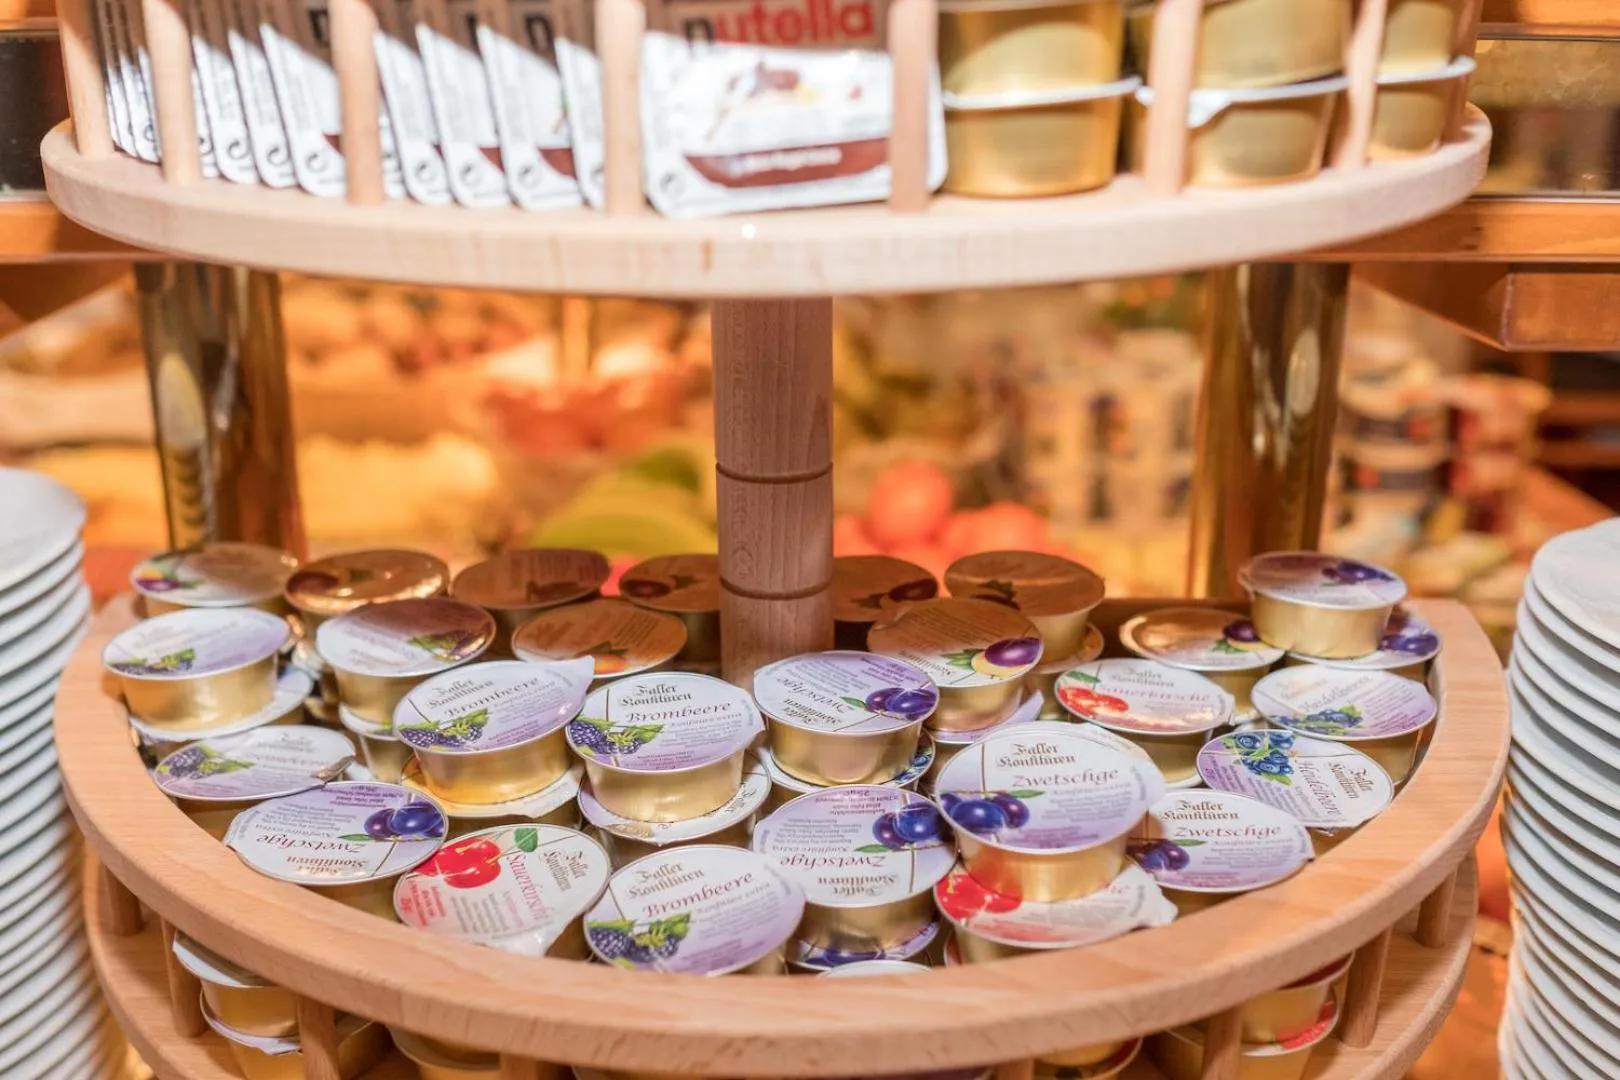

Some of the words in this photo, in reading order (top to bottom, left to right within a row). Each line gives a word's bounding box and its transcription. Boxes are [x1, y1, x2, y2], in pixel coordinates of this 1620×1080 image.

[683, 0, 876, 46] nutella
[445, 677, 539, 717] Brombeere
[634, 684, 678, 697] Faller
[626, 702, 731, 723] Brombeere
[1012, 743, 1058, 756] Faller
[1012, 768, 1119, 786] Zwetschge
[1177, 799, 1223, 811] Faller
[1174, 825, 1281, 839] Zwetschge
[256, 833, 367, 853] Zwetschge
[636, 862, 683, 882] Faller
[780, 855, 887, 870] Zwetschge
[643, 872, 754, 918] Brombeere
